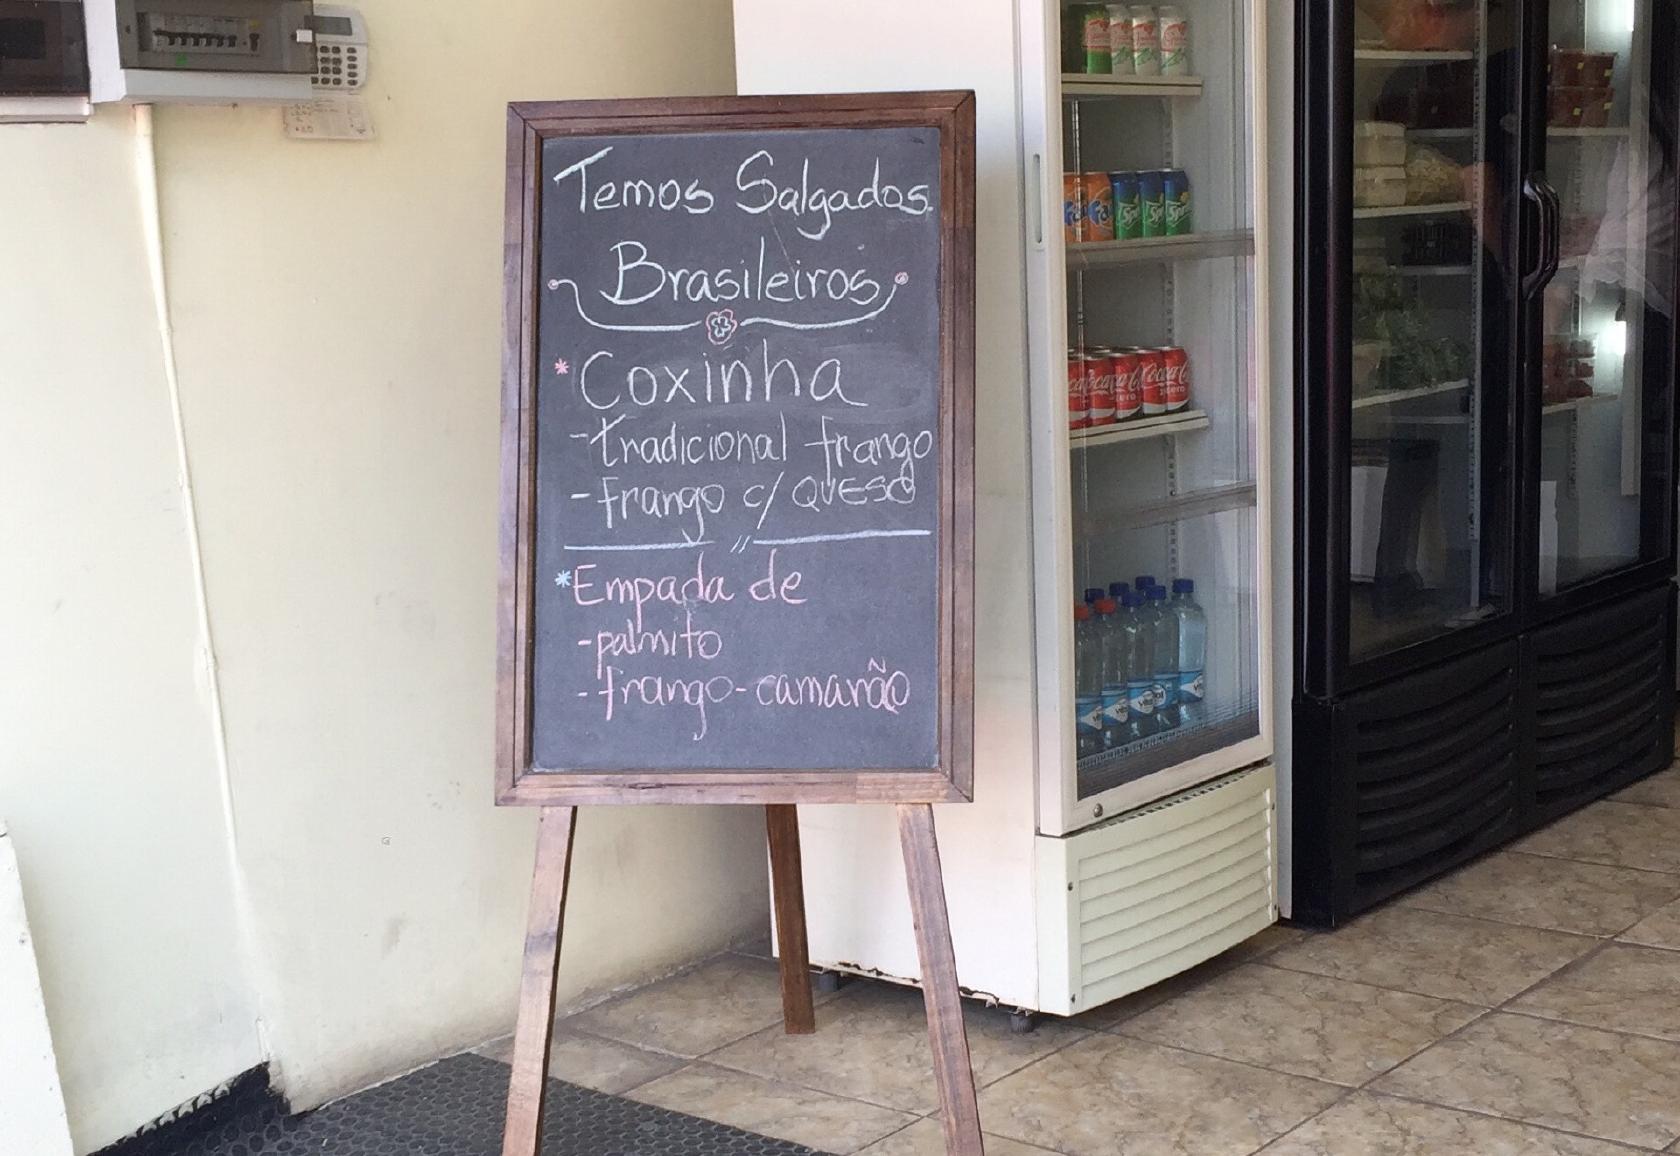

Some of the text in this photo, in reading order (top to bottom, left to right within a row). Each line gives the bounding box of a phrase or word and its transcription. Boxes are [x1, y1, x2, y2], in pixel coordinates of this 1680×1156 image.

[553, 146, 714, 214] Temos
[599, 236, 880, 305] Brasileiros
[581, 338, 868, 409] Coxinha
[573, 548, 807, 634] Empada de
